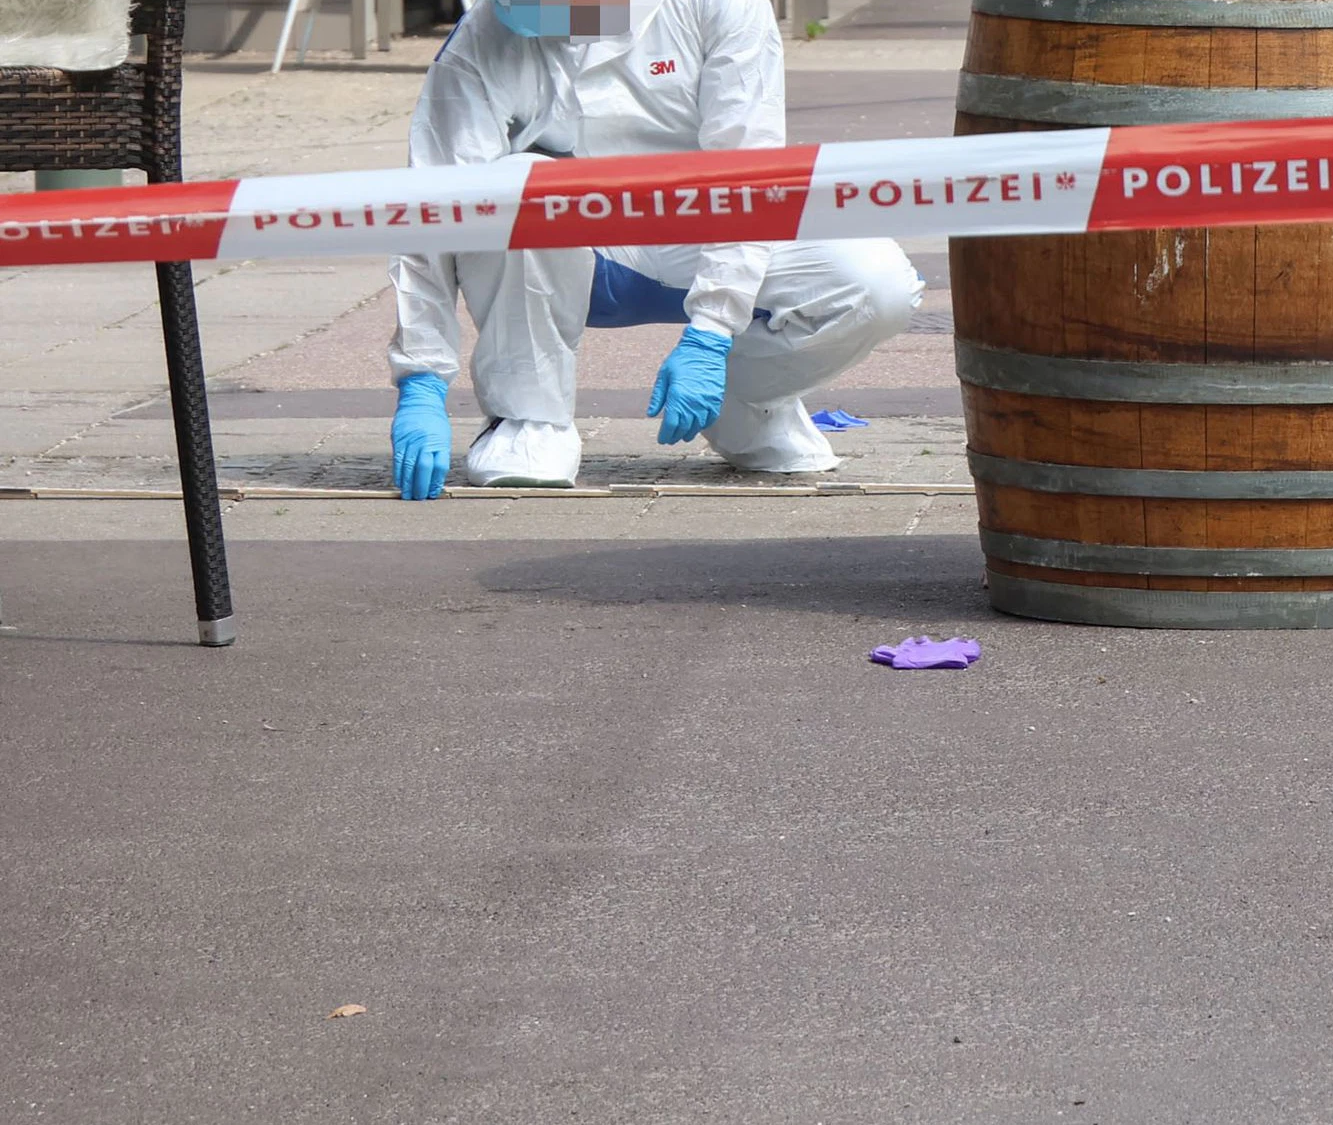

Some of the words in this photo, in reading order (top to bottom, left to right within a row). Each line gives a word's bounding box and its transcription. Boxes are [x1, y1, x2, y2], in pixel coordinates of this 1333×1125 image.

[650, 60, 676, 76] 3M
[254, 201, 464, 231] POLIZEI
[543, 185, 753, 221] POLIZEI
[834, 172, 1042, 209] POLIZEI
[1123, 158, 1329, 198] POLIZEI
